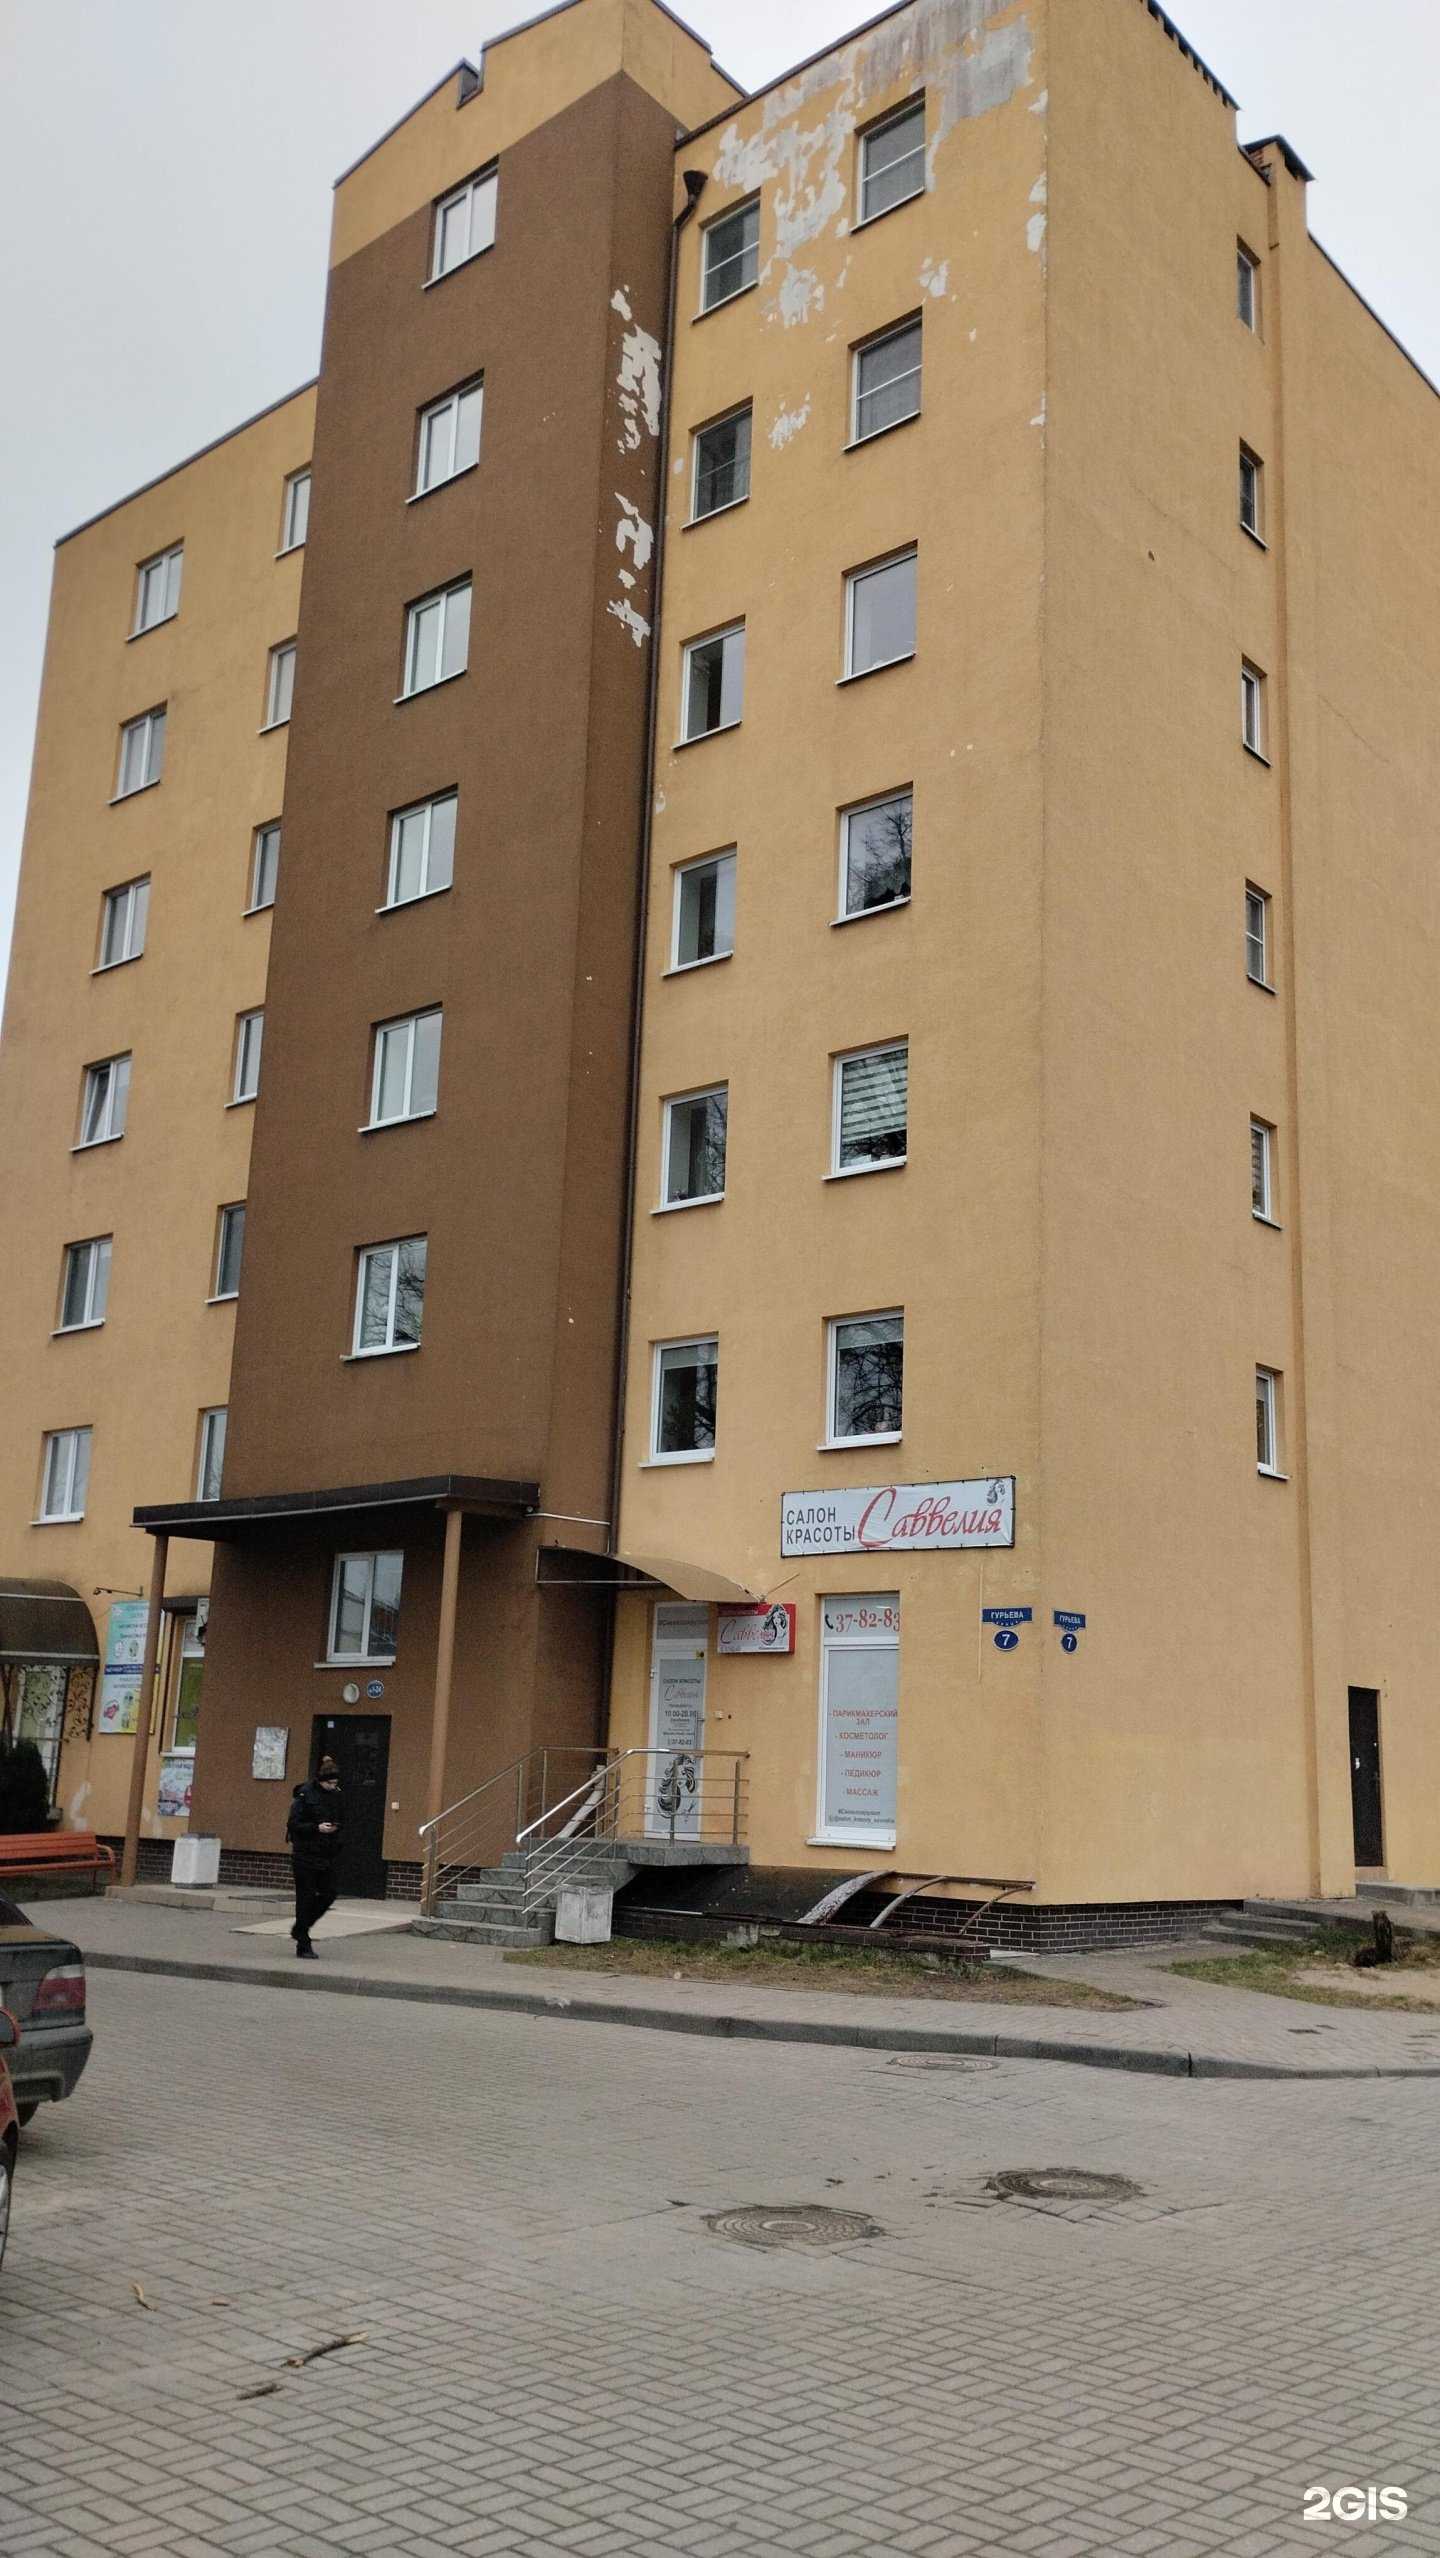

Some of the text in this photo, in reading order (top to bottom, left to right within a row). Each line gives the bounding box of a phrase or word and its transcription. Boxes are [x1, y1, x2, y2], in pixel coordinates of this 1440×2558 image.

[786, 1506, 837, 1525] САЛОН
[858, 1487, 1002, 1548] Саввелия
[786, 1526, 855, 1545] КРАСОТЫ
[835, 1608, 900, 1633] 37-82-83
[990, 1610, 1024, 1620] ГУРЬЕВА
[1059, 1614, 1081, 1625] ГУРЬЕВА
[1001, 1633, 1011, 1647] 7
[1066, 1636, 1073, 1649] 7
[832, 1709, 898, 1718] ПАРИКМАХЕРСКИЙ
[839, 1732, 888, 1740] КОСМЕТОЛОГ
[844, 1750, 882, 1759] МАНИКЮР
[844, 1769, 881, 1778] ПЕДИКЮР
[846, 1788, 879, 1797] МАССАЖ
